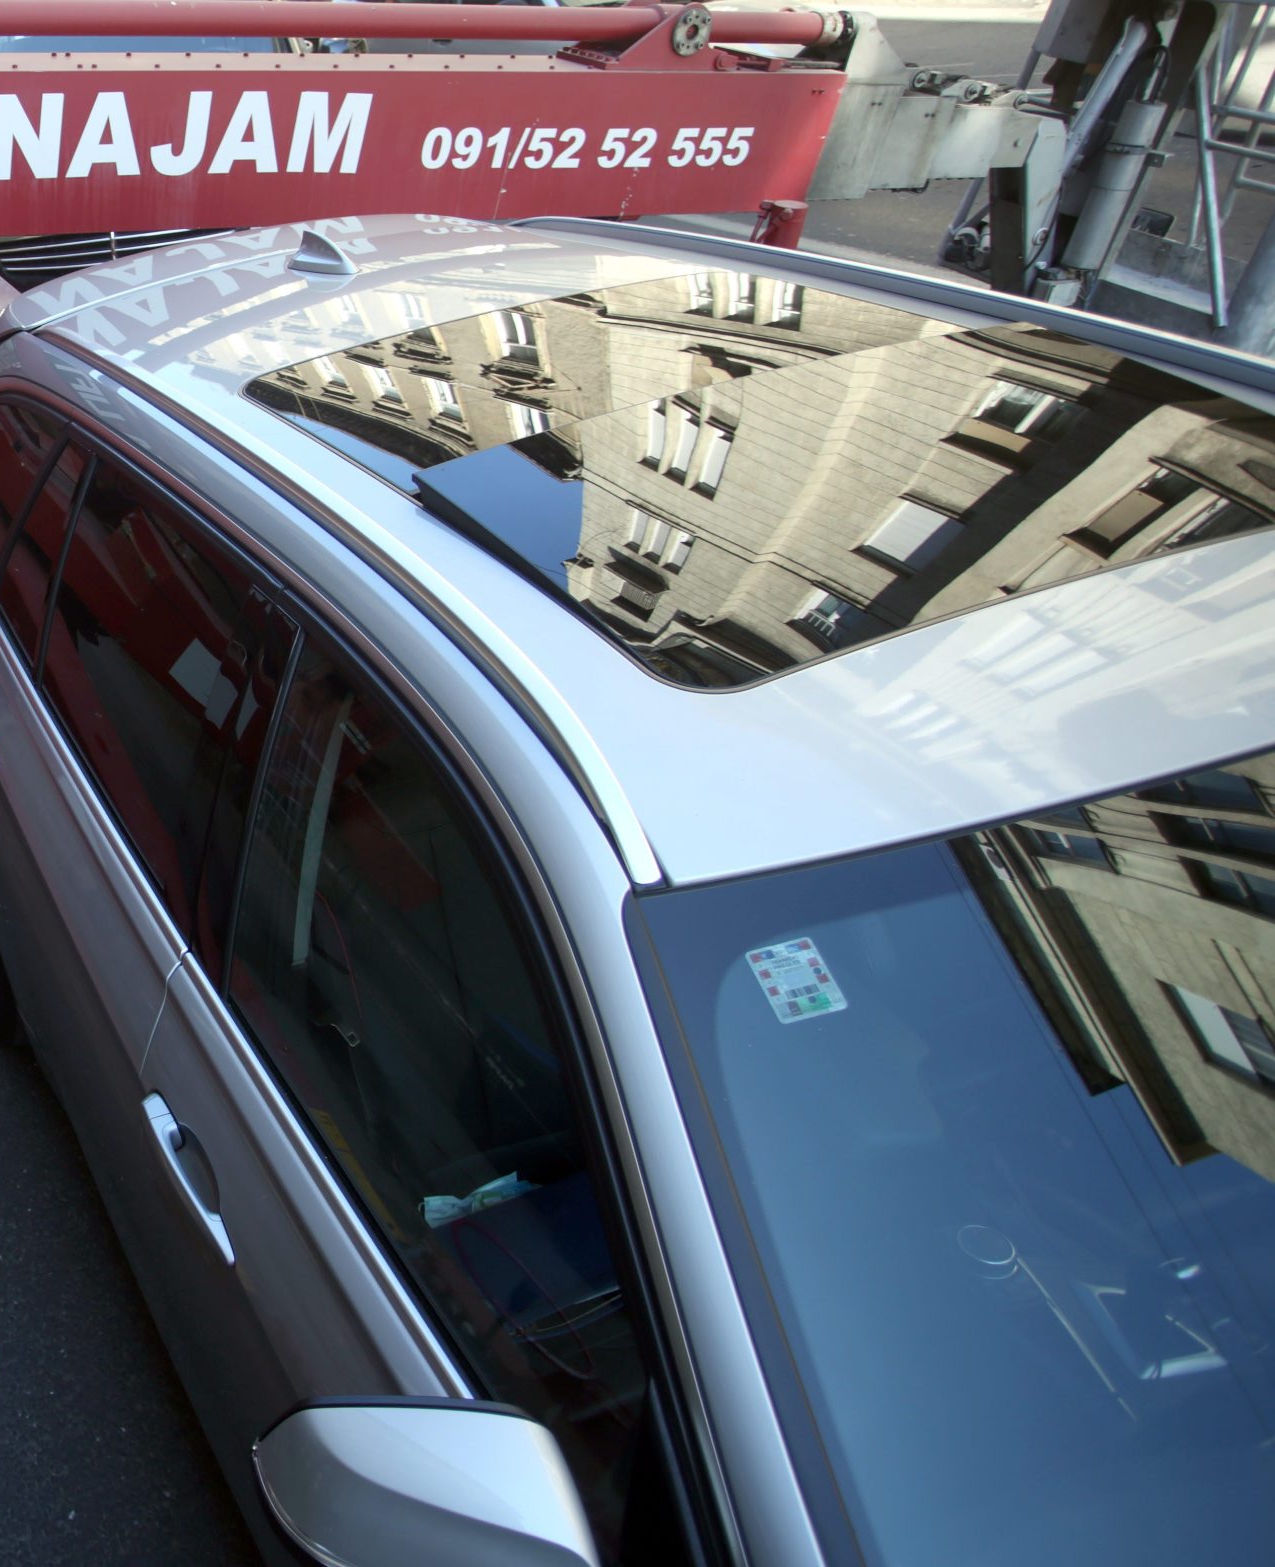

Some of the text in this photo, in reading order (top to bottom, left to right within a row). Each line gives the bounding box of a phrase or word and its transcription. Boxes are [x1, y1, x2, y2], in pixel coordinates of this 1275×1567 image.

[421, 126, 755, 170] 091/52 52 555
